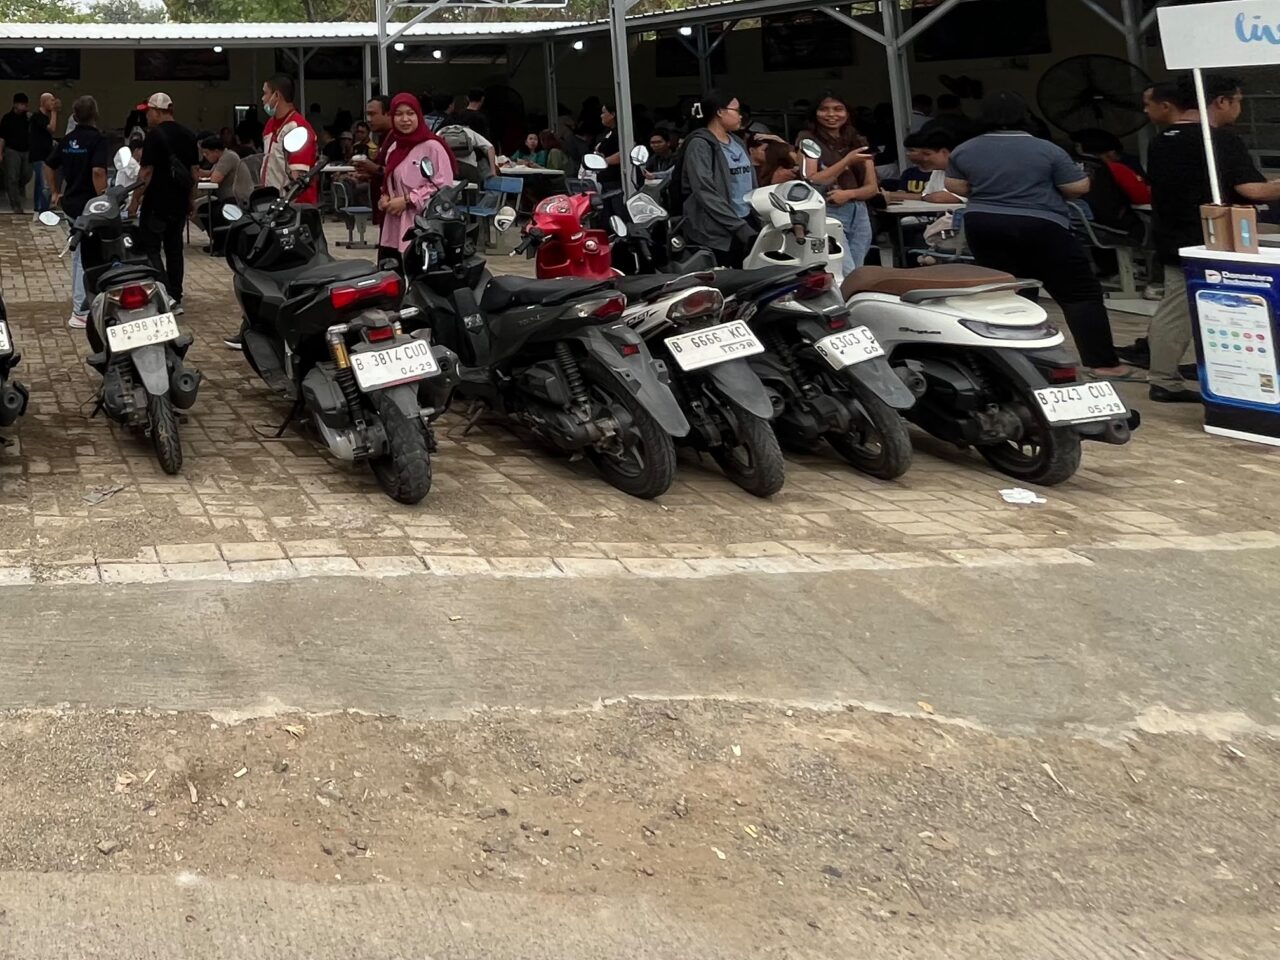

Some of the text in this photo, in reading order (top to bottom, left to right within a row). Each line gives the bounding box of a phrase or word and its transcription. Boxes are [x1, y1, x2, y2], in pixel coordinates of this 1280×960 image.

[110, 328, 117, 338] B
[671, 341, 683, 354] B
[690, 332, 722, 349] 6666
[355, 358, 365, 371] B
[403, 343, 428, 360] CUD
[1037, 392, 1048, 406] B
